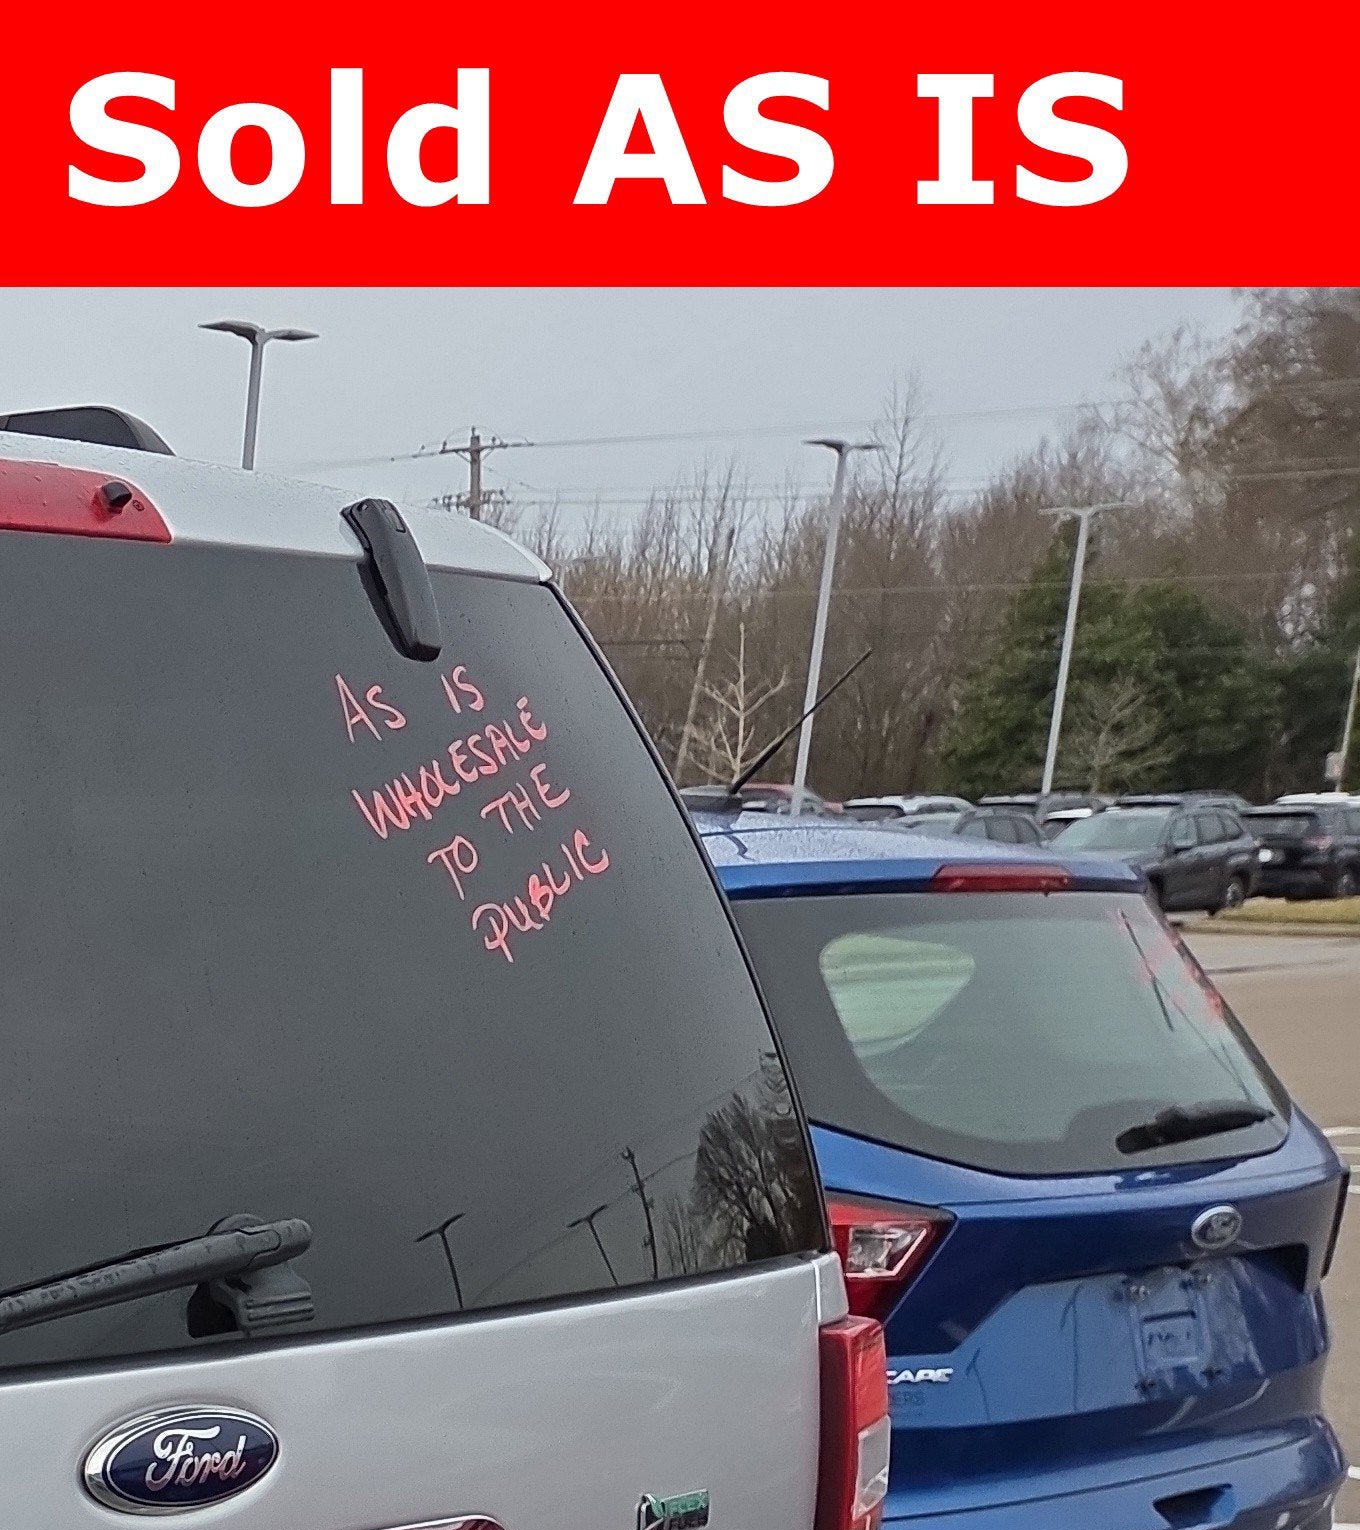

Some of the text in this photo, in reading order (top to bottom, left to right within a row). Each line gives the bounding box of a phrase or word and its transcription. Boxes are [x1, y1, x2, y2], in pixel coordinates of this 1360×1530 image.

[336, 665, 485, 744] AS IS
[351, 696, 547, 840] WHOLESALE
[427, 763, 570, 901] TO THE
[471, 829, 610, 963] PUBLIC
[885, 1367, 954, 1385] CAPE
[145, 1425, 247, 1492] Ford
